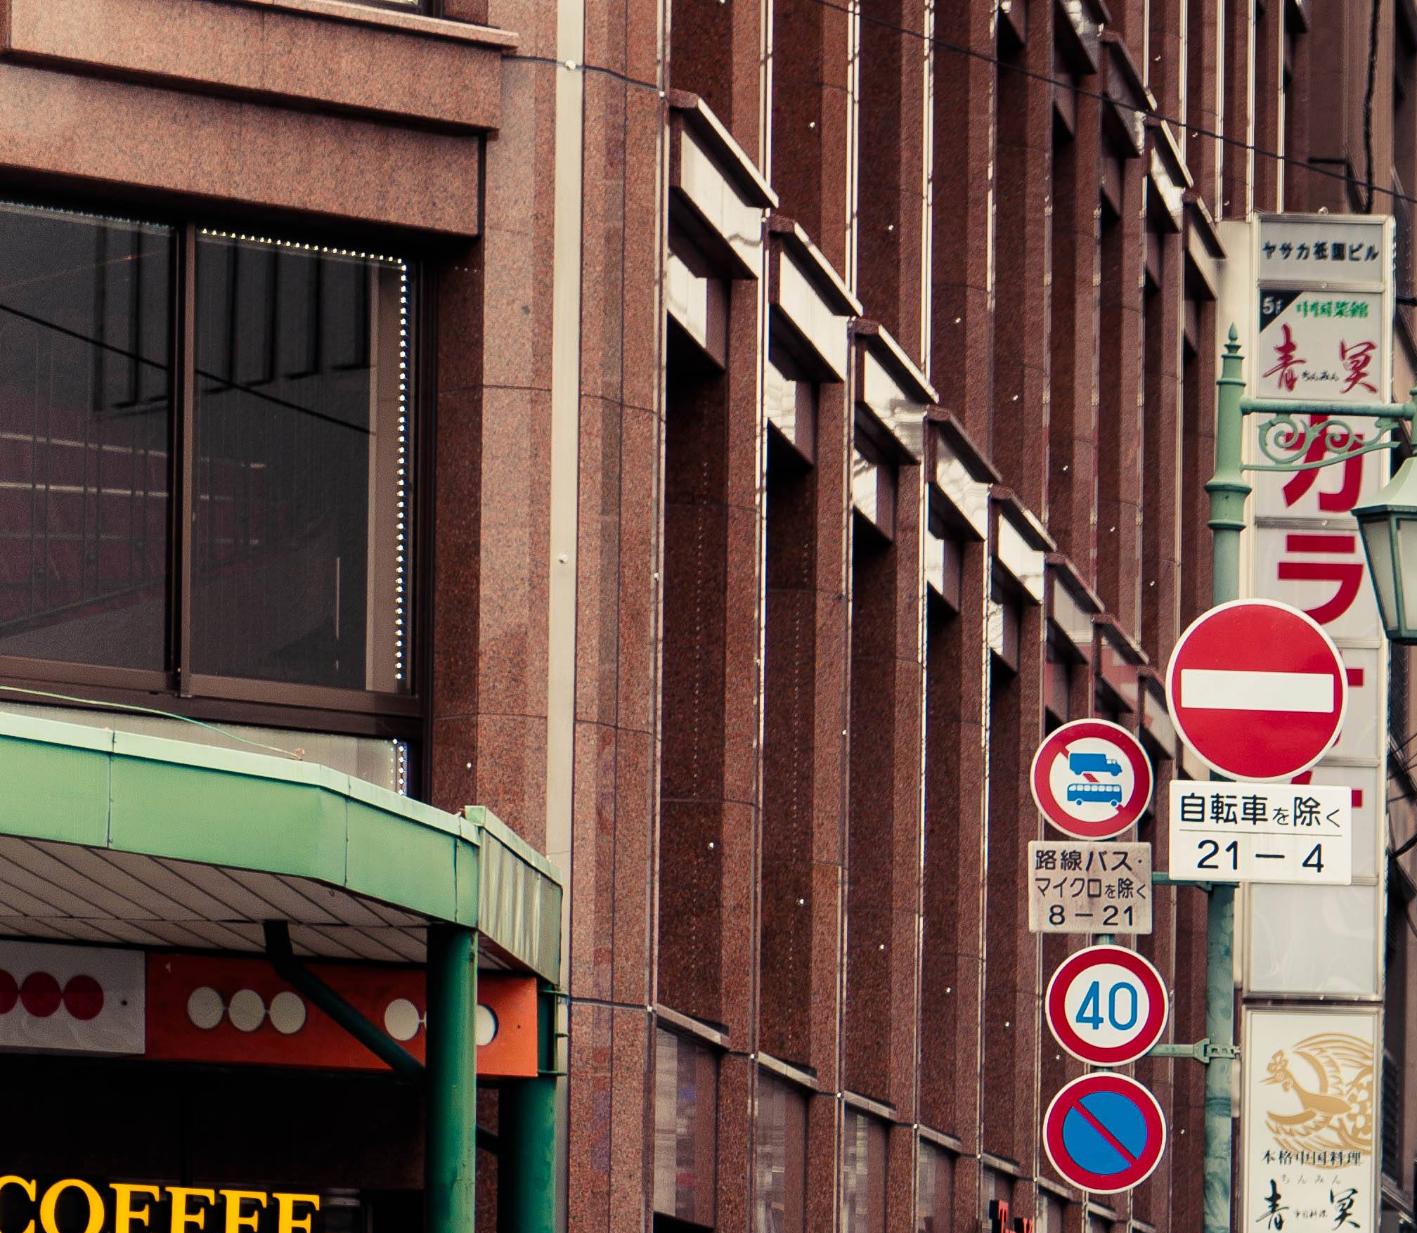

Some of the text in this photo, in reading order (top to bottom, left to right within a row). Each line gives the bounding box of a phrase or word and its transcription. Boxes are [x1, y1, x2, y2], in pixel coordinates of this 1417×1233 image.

[1263, 241, 1380, 262] ヤサカ祇園ビル
[1180, 792, 1341, 828] 自転車を除く
[1034, 876, 1147, 900] マイクロを除く
[1075, 980, 1138, 1031] 40
